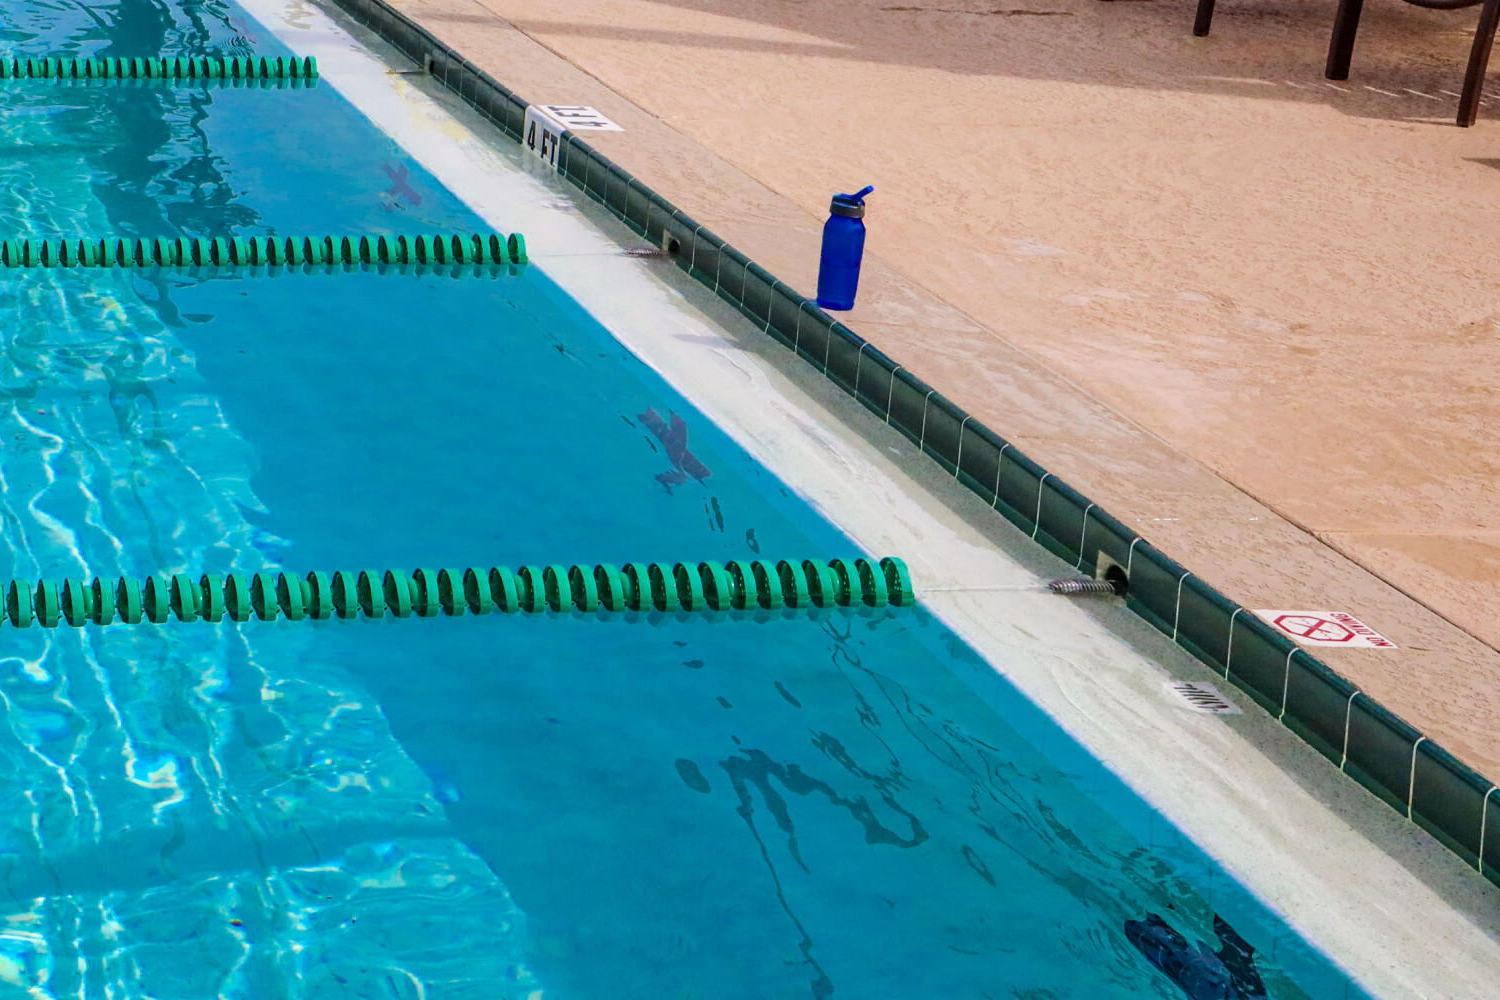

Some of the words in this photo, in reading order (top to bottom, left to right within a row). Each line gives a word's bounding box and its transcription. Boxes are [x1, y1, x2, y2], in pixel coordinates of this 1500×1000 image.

[528, 120, 536, 151] 4
[541, 128, 559, 166] FT
[1330, 613, 1377, 636] DIVING
[1366, 636, 1393, 647] NO
